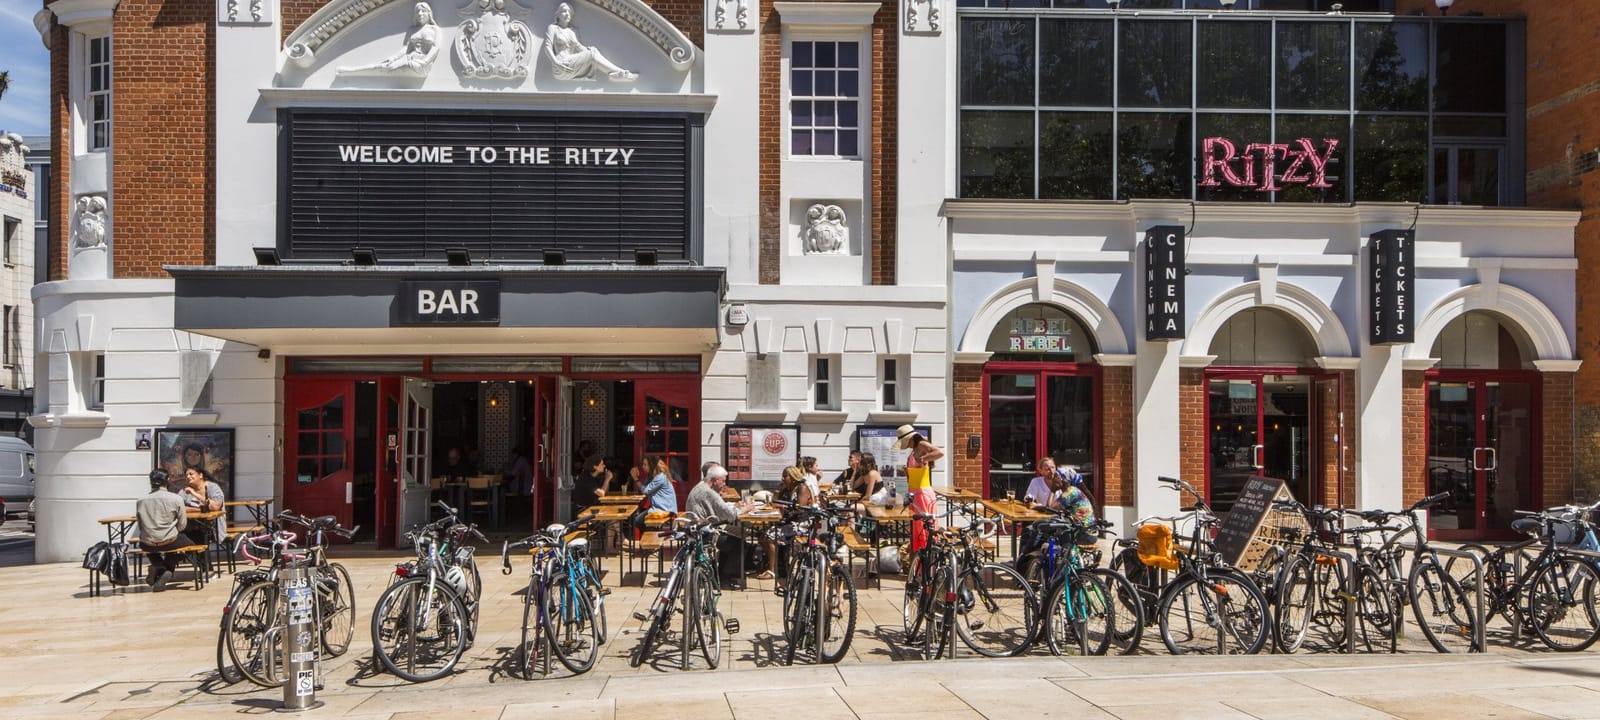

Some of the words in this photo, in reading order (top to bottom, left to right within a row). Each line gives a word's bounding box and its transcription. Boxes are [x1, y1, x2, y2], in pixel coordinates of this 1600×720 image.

[339, 145, 453, 164] WELCOME
[466, 146, 498, 164] TO
[505, 147, 550, 165] THE
[564, 148, 635, 165] RITZY
[1147, 235, 1155, 333] CINEMA
[1164, 233, 1179, 332] CINEMA
[1396, 237, 1406, 336] TICKETS
[417, 289, 480, 315] BAR
[1009, 335, 1072, 353] REBEL
[769, 439, 782, 448] UP
[298, 671, 313, 679] PIC
